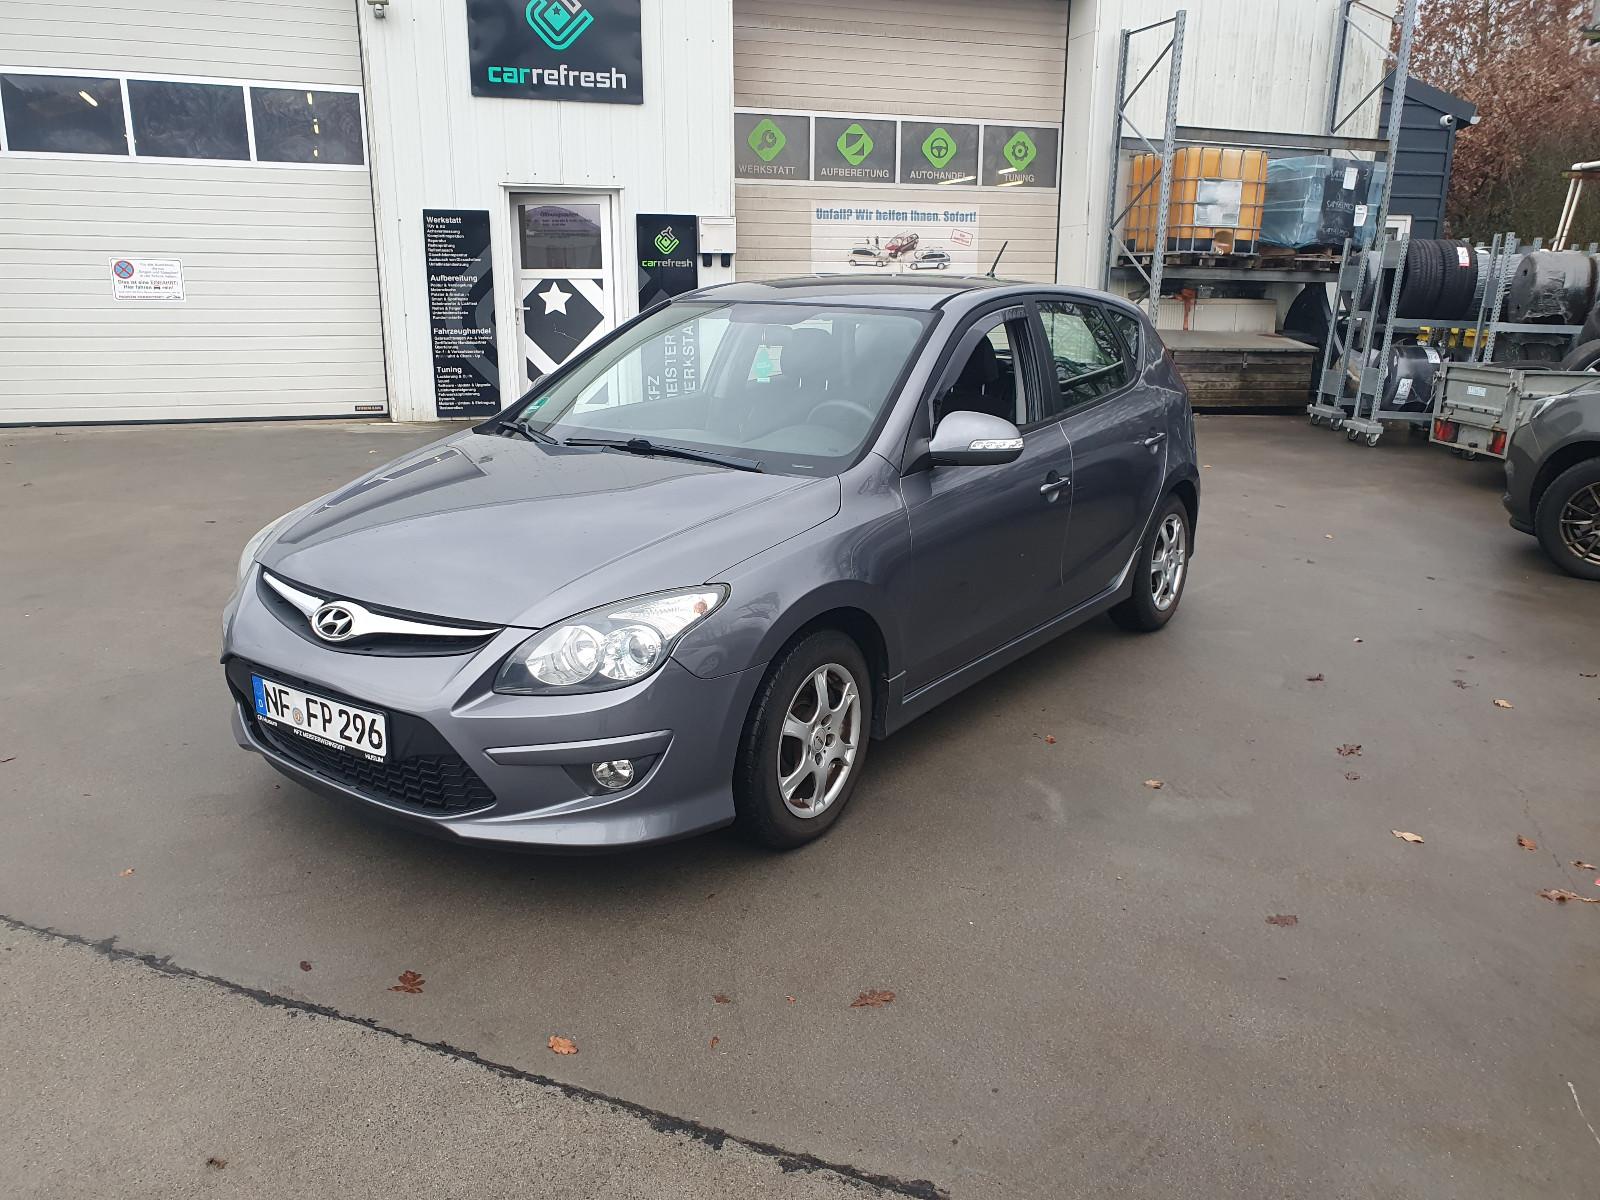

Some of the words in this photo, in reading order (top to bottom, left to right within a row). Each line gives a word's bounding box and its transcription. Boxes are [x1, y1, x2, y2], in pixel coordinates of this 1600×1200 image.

[488, 64, 627, 89] carrefresh
[738, 164, 796, 176] WERKSTATT
[820, 167, 890, 178] AUFBEREITUNG
[910, 170, 966, 180] AUTOHANDEL
[1004, 174, 1035, 183] TUNING
[816, 208, 852, 220] Unfall?
[856, 208, 874, 220] Wir
[876, 210, 908, 222] helfen
[910, 210, 940, 222] Ihnen.
[944, 210, 976, 222] Sofort!
[641, 258, 693, 268] carrefresh
[436, 366, 462, 374] Tuning
[264, 683, 290, 718] NF
[305, 697, 332, 732] FP
[338, 708, 383, 750] 296
